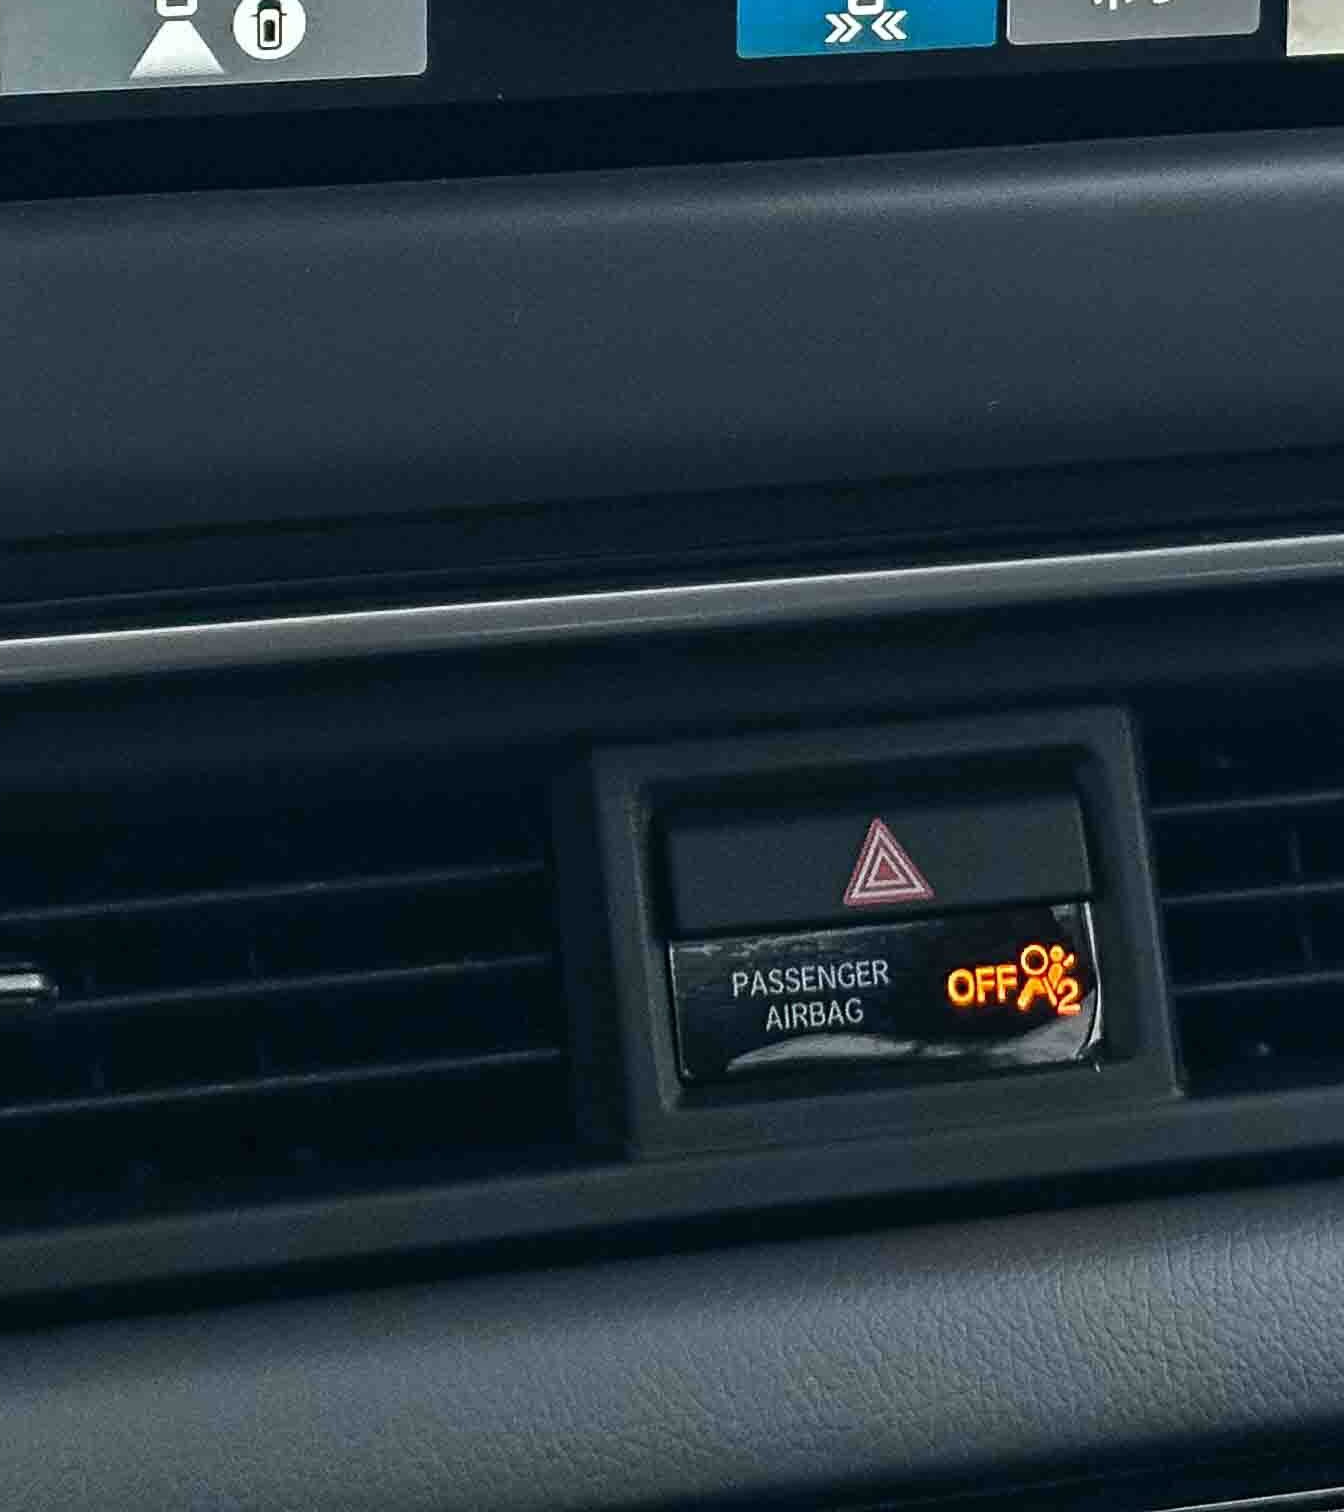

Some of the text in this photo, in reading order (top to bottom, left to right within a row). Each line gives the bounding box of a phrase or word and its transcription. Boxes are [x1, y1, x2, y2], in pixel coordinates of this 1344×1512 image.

[732, 960, 889, 998] PASSENGER
[947, 964, 1018, 1007] OFF
[765, 998, 864, 1032] AIRBAG
